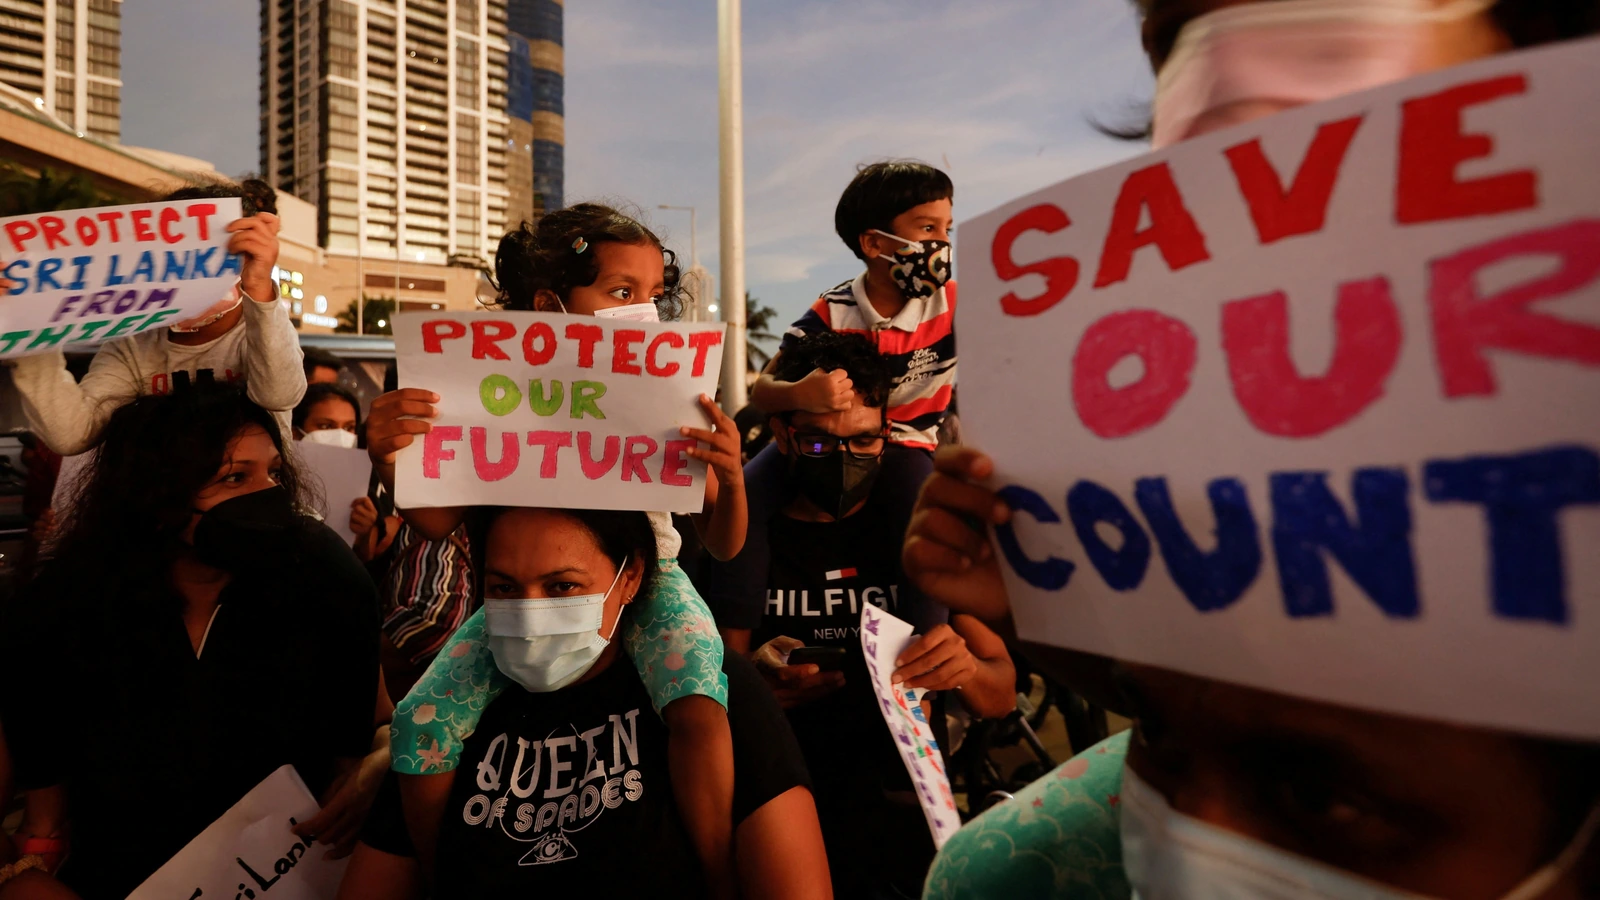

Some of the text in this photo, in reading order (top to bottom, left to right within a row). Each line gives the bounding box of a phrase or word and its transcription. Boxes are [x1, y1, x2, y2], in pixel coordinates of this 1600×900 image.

[991, 72, 1543, 318] SAVE
[4, 203, 217, 252] PROTECT
[3, 246, 241, 296] SRI LANKA
[0, 308, 181, 353] THIEF
[51, 287, 179, 323] FROM
[1071, 217, 1600, 440] OUR
[421, 319, 723, 377] PROTECT
[479, 373, 607, 420] OUR
[422, 425, 699, 487] FUTURE
[994, 444, 1600, 628] COUNT
[814, 626, 848, 640] NEW
[476, 708, 640, 798] QUEEN
[463, 769, 644, 832] OF SPADES
